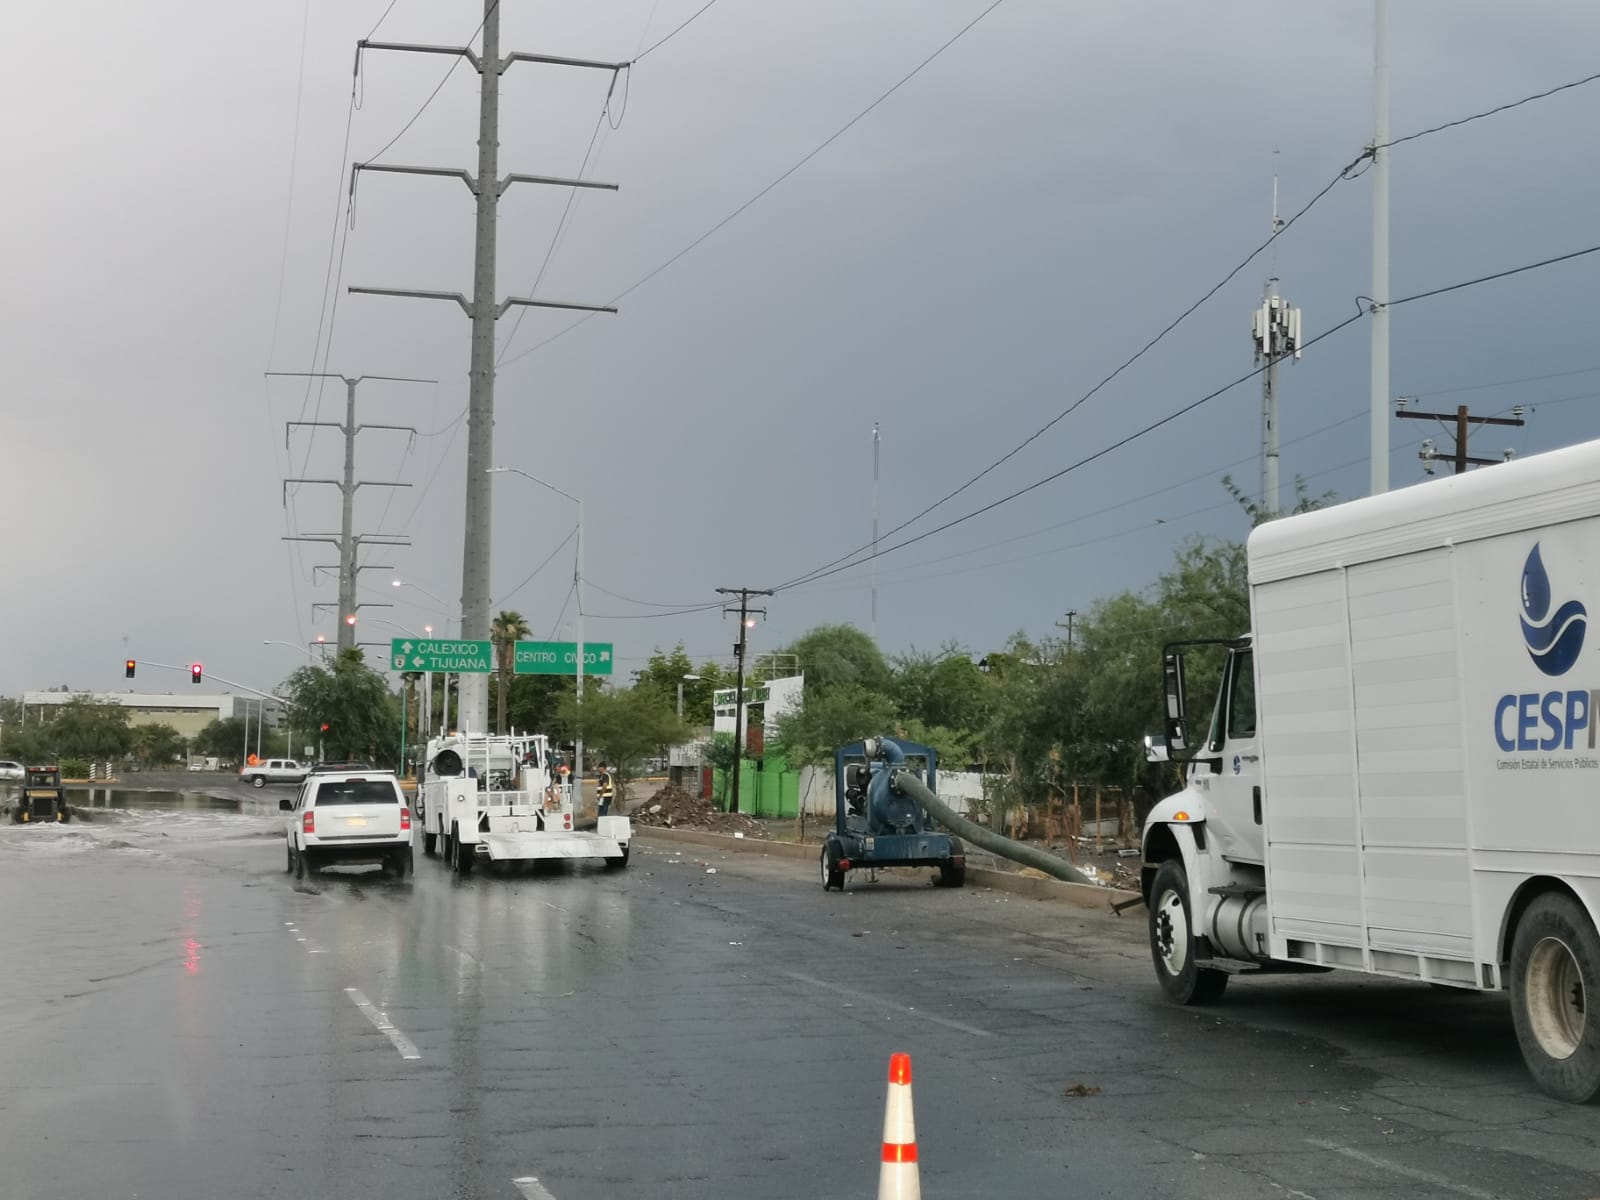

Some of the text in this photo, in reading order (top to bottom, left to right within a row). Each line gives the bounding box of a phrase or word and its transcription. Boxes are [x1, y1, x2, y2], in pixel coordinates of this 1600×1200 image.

[417, 642, 479, 655] CALEXICO
[429, 657, 487, 670] TIJUANA
[516, 651, 597, 664] CENTRO CIVCO
[1522, 758, 1539, 769] Estatal
[1541, 758, 1547, 769] de
[1549, 758, 1573, 769] Servicios
